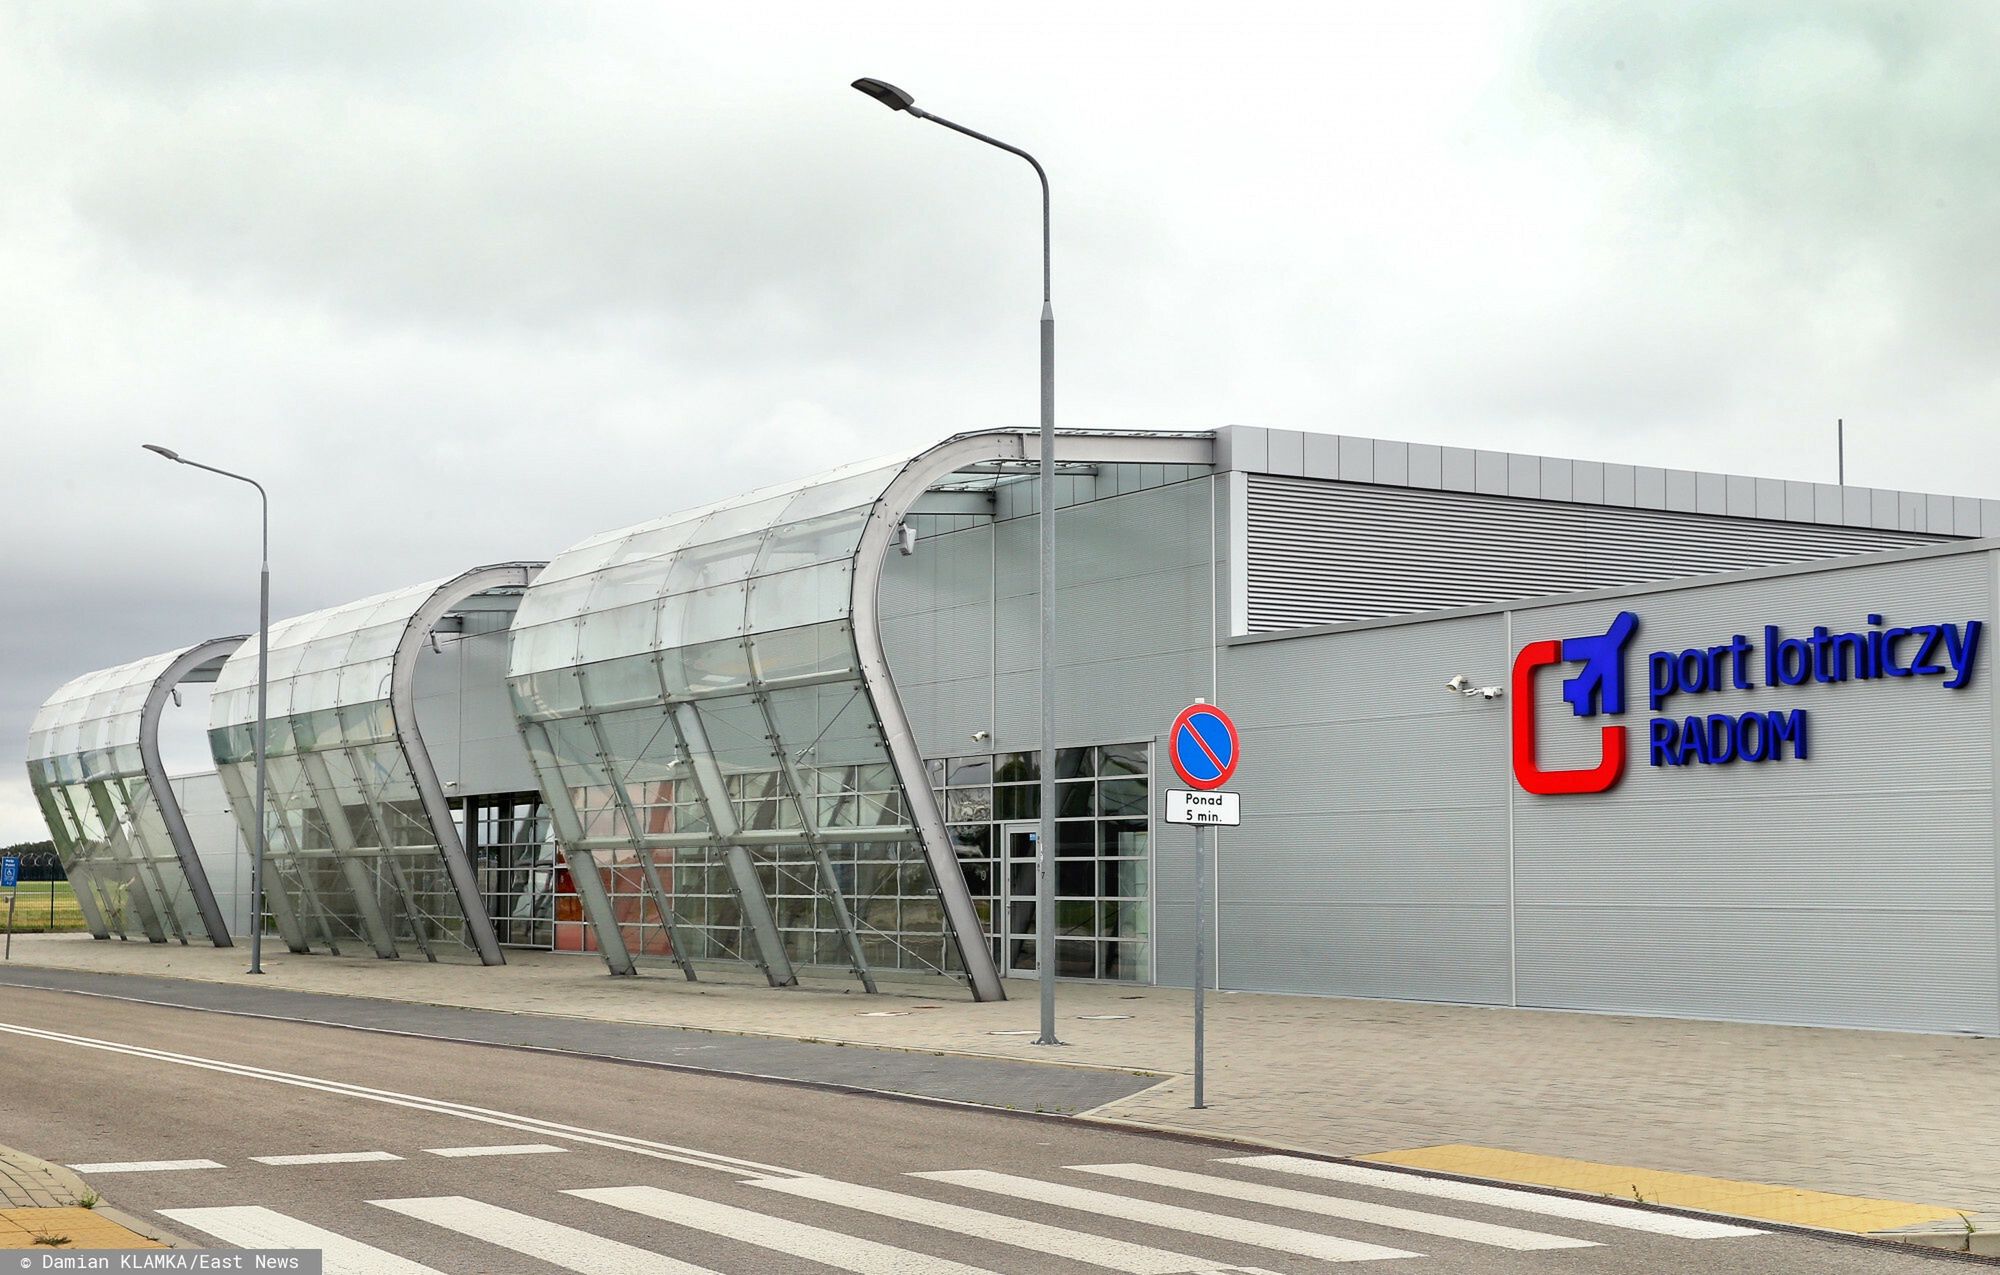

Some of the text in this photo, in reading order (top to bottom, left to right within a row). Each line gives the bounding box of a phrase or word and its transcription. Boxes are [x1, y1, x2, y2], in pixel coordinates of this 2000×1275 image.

[1649, 614, 1981, 710] port lotniczy
[1650, 709, 1807, 766] RADOM
[1186, 793, 1222, 806] Ponad
[1186, 810, 1222, 822] 5 min.
